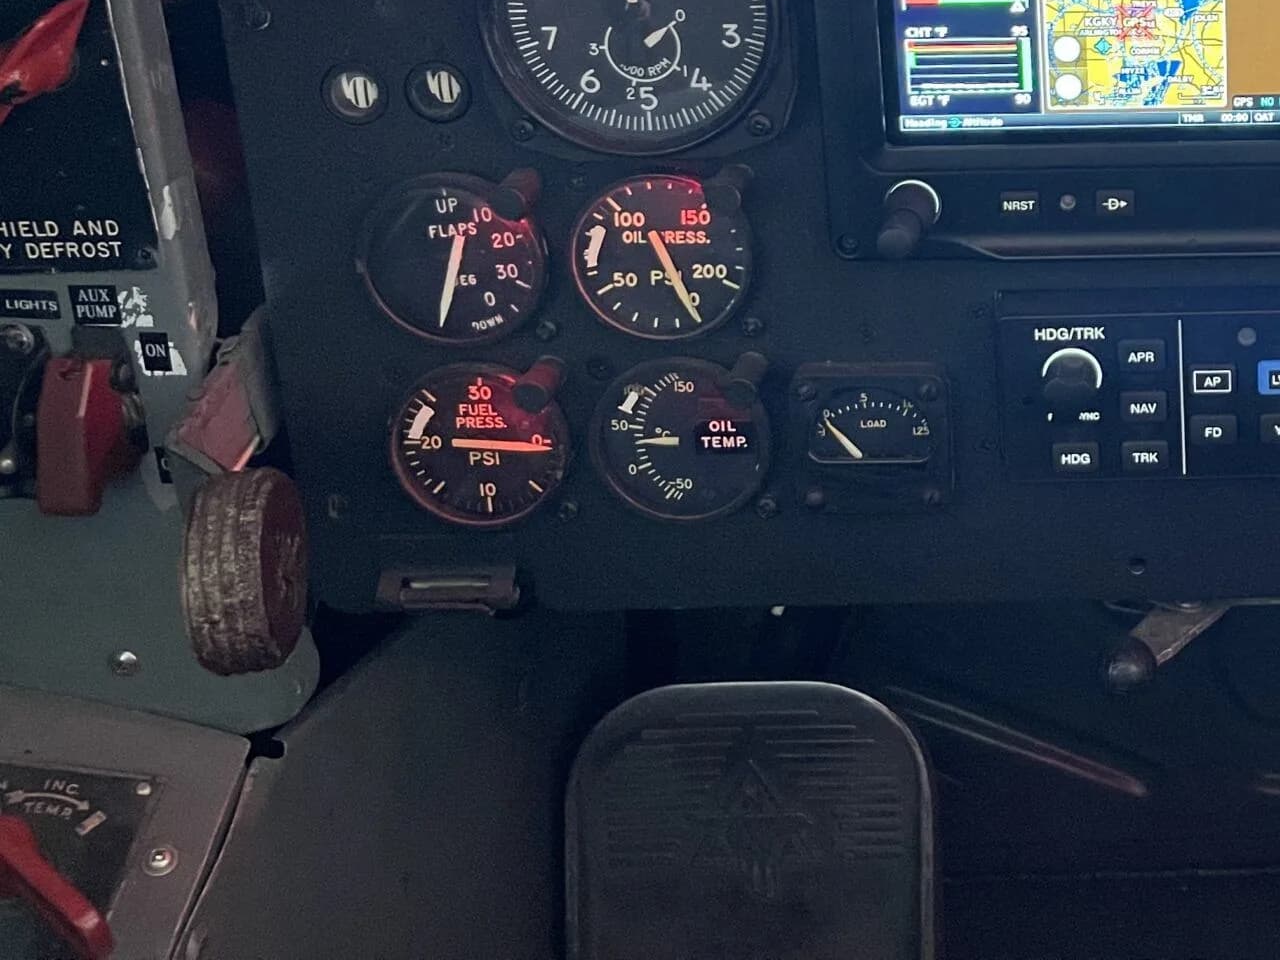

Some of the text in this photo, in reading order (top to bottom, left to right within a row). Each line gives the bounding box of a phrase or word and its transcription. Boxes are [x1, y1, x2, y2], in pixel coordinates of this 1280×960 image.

[541, 27, 557, 50] 7
[722, 24, 741, 48] 3
[580, 69, 600, 93] 6
[690, 68, 712, 90] 4
[640, 87, 658, 110] 5
[436, 198, 458, 214] UP
[1003, 199, 1035, 211] NRST
[473, 208, 491, 222] 10
[614, 212, 645, 227] 100
[680, 210, 710, 225] 150
[74, 220, 119, 236] AND
[429, 222, 477, 239] FLAPS
[492, 233, 516, 248] 20
[623, 231, 646, 244] OIL
[25, 242, 121, 258] DEFROST
[496, 264, 518, 279] 30
[693, 264, 727, 279] 200
[613, 272, 637, 287] 50
[79, 289, 110, 301] AUX
[6, 299, 57, 310] LIGHTS
[76, 305, 116, 318] PUMP
[1034, 327, 1105, 340] HDG/TRK
[146, 344, 166, 357] ON
[1128, 351, 1154, 363] APR
[674, 381, 694, 392] 150
[1203, 376, 1221, 387] AP
[468, 385, 492, 400] 30
[459, 404, 497, 416] FUEL
[1130, 403, 1157, 414] NAV
[455, 416, 507, 429] PRESS.
[611, 420, 628, 431] 50
[709, 420, 736, 432] OIL
[861, 419, 886, 428] LOAD
[1205, 426, 1221, 438] FD
[421, 436, 442, 449] 20
[701, 436, 748, 448] TEMP.
[469, 452, 500, 466] PSI
[1062, 453, 1090, 464] HDG
[1132, 451, 1158, 463] TRK
[480, 483, 496, 497] 10
[44, 780, 80, 794] INC
